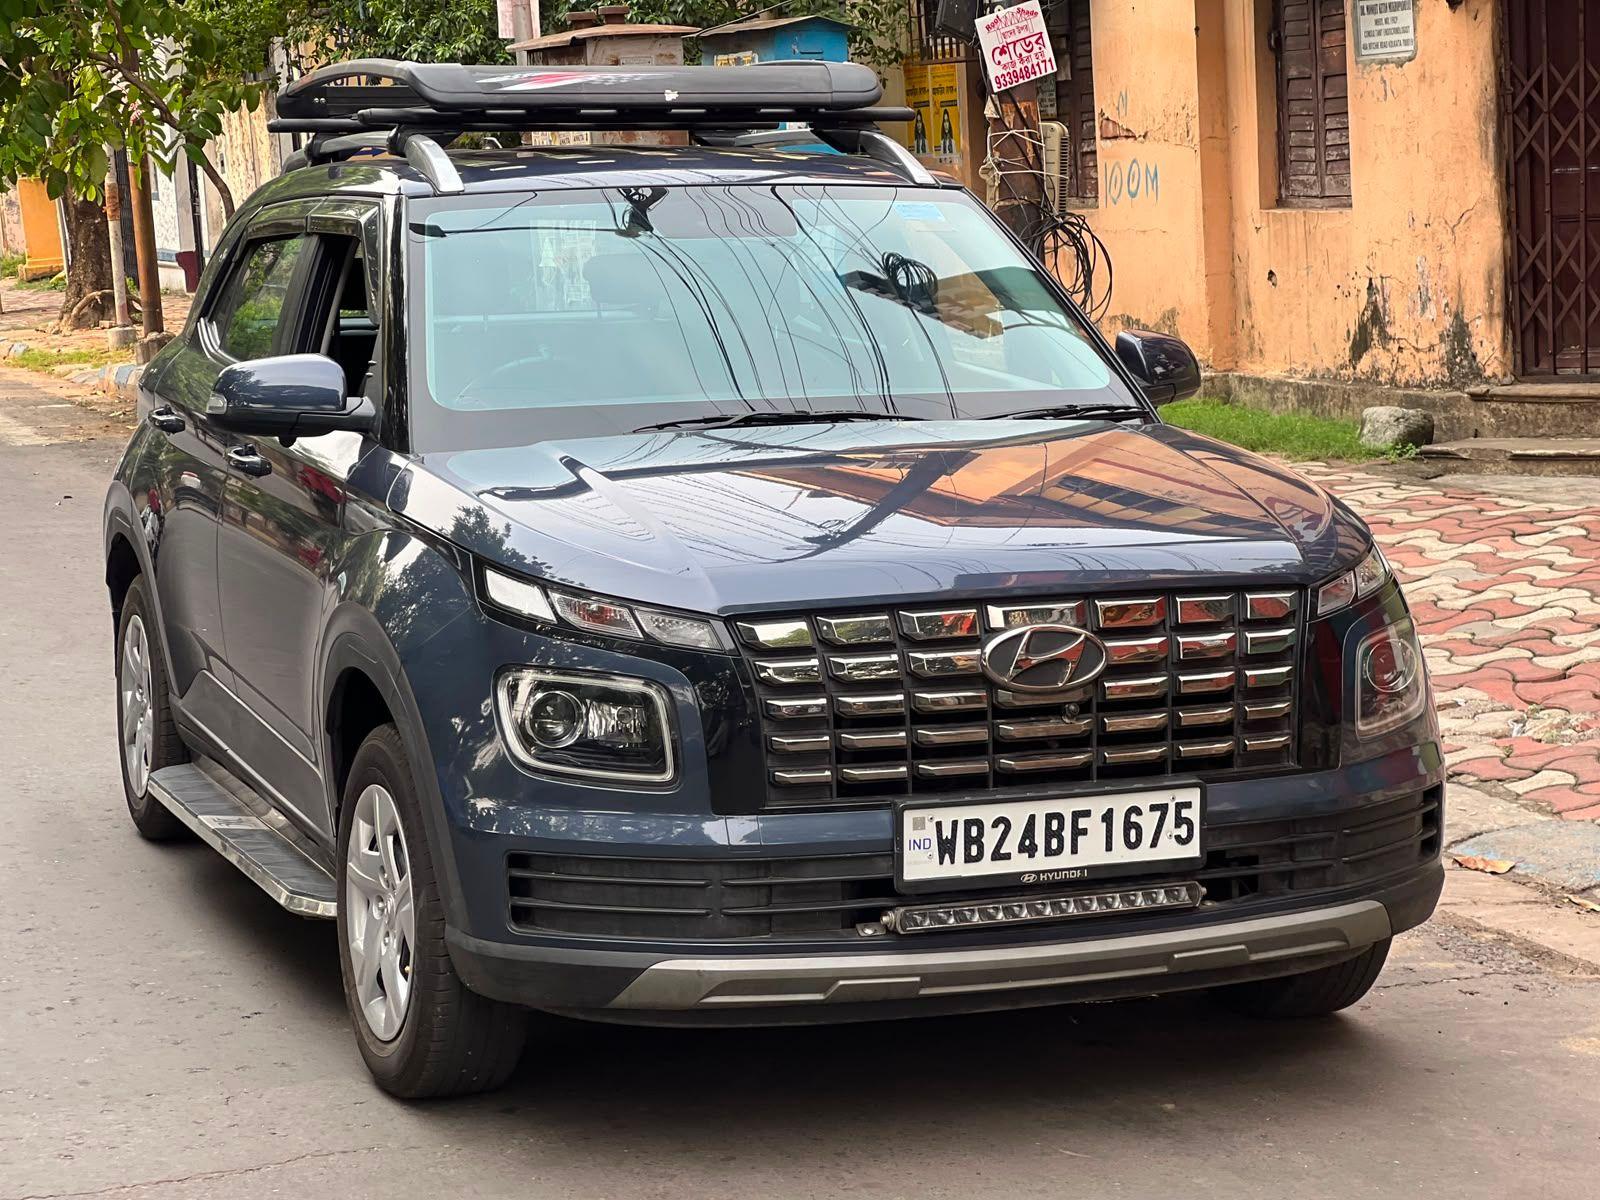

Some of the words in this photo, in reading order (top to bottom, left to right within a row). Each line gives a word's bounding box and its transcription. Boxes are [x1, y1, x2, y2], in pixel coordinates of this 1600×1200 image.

[1016, 7, 1039, 17] Shade
[992, 32, 1046, 66] শেডের
[994, 57, 1055, 90] 9339484171
[1104, 158, 1159, 208] 100M
[909, 838, 932, 851] IND
[935, 801, 1194, 866] WB24BF1675
